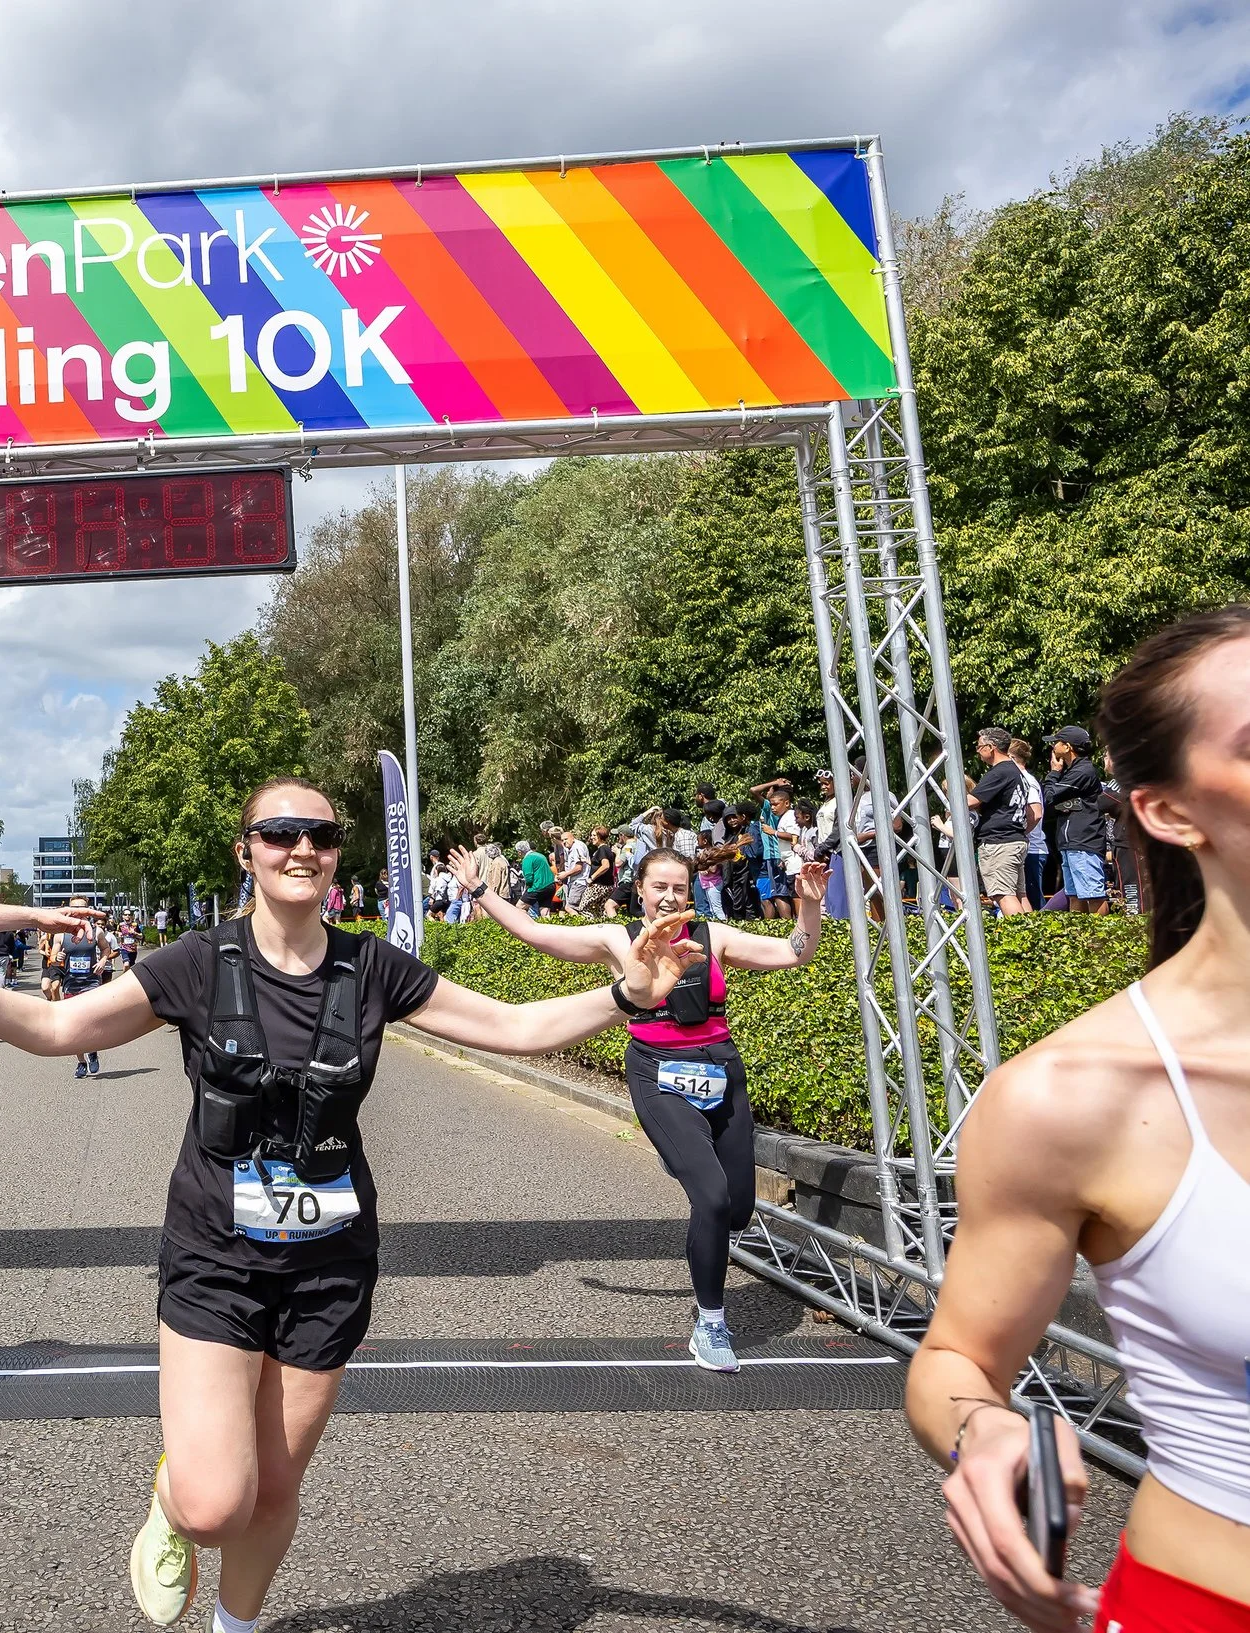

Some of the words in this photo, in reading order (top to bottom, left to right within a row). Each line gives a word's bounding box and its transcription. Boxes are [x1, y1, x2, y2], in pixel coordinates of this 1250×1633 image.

[210, 304, 414, 394] 10K
[397, 800, 410, 869] GOOD
[386, 802, 400, 909] RUNNING
[673, 1076, 712, 1096] 514
[314, 1143, 348, 1152] TENTRA
[272, 1191, 321, 1225] 70
[265, 1231, 279, 1240] UP
[289, 1229, 330, 1240] RUNNING
